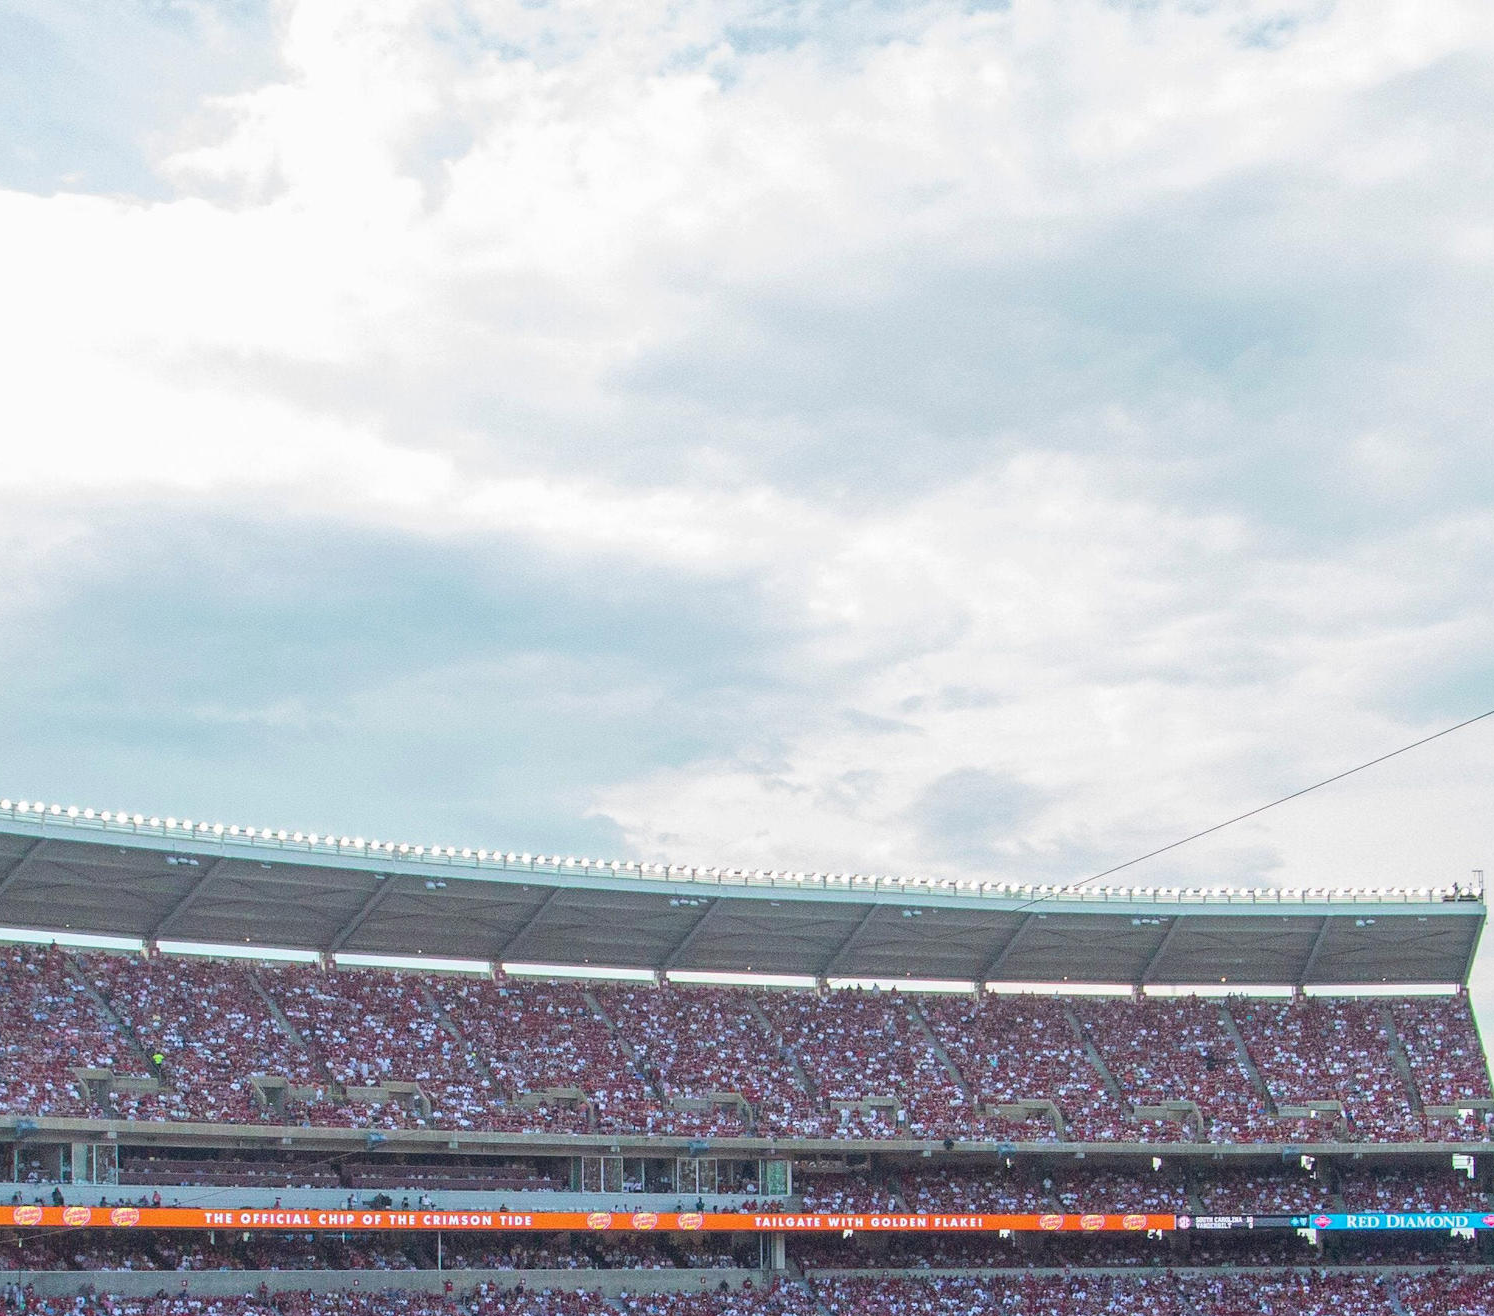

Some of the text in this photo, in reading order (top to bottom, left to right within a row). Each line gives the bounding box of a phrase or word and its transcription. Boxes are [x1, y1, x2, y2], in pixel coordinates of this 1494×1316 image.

[205, 1213, 532, 1226] THE OFFICIAL CHIP OF THE CRIMSON TIDE
[755, 1217, 983, 1228] TAILGATE WITH GOLDEN FLAKE!
[1347, 1214, 1469, 1228] RED DIAMOND
